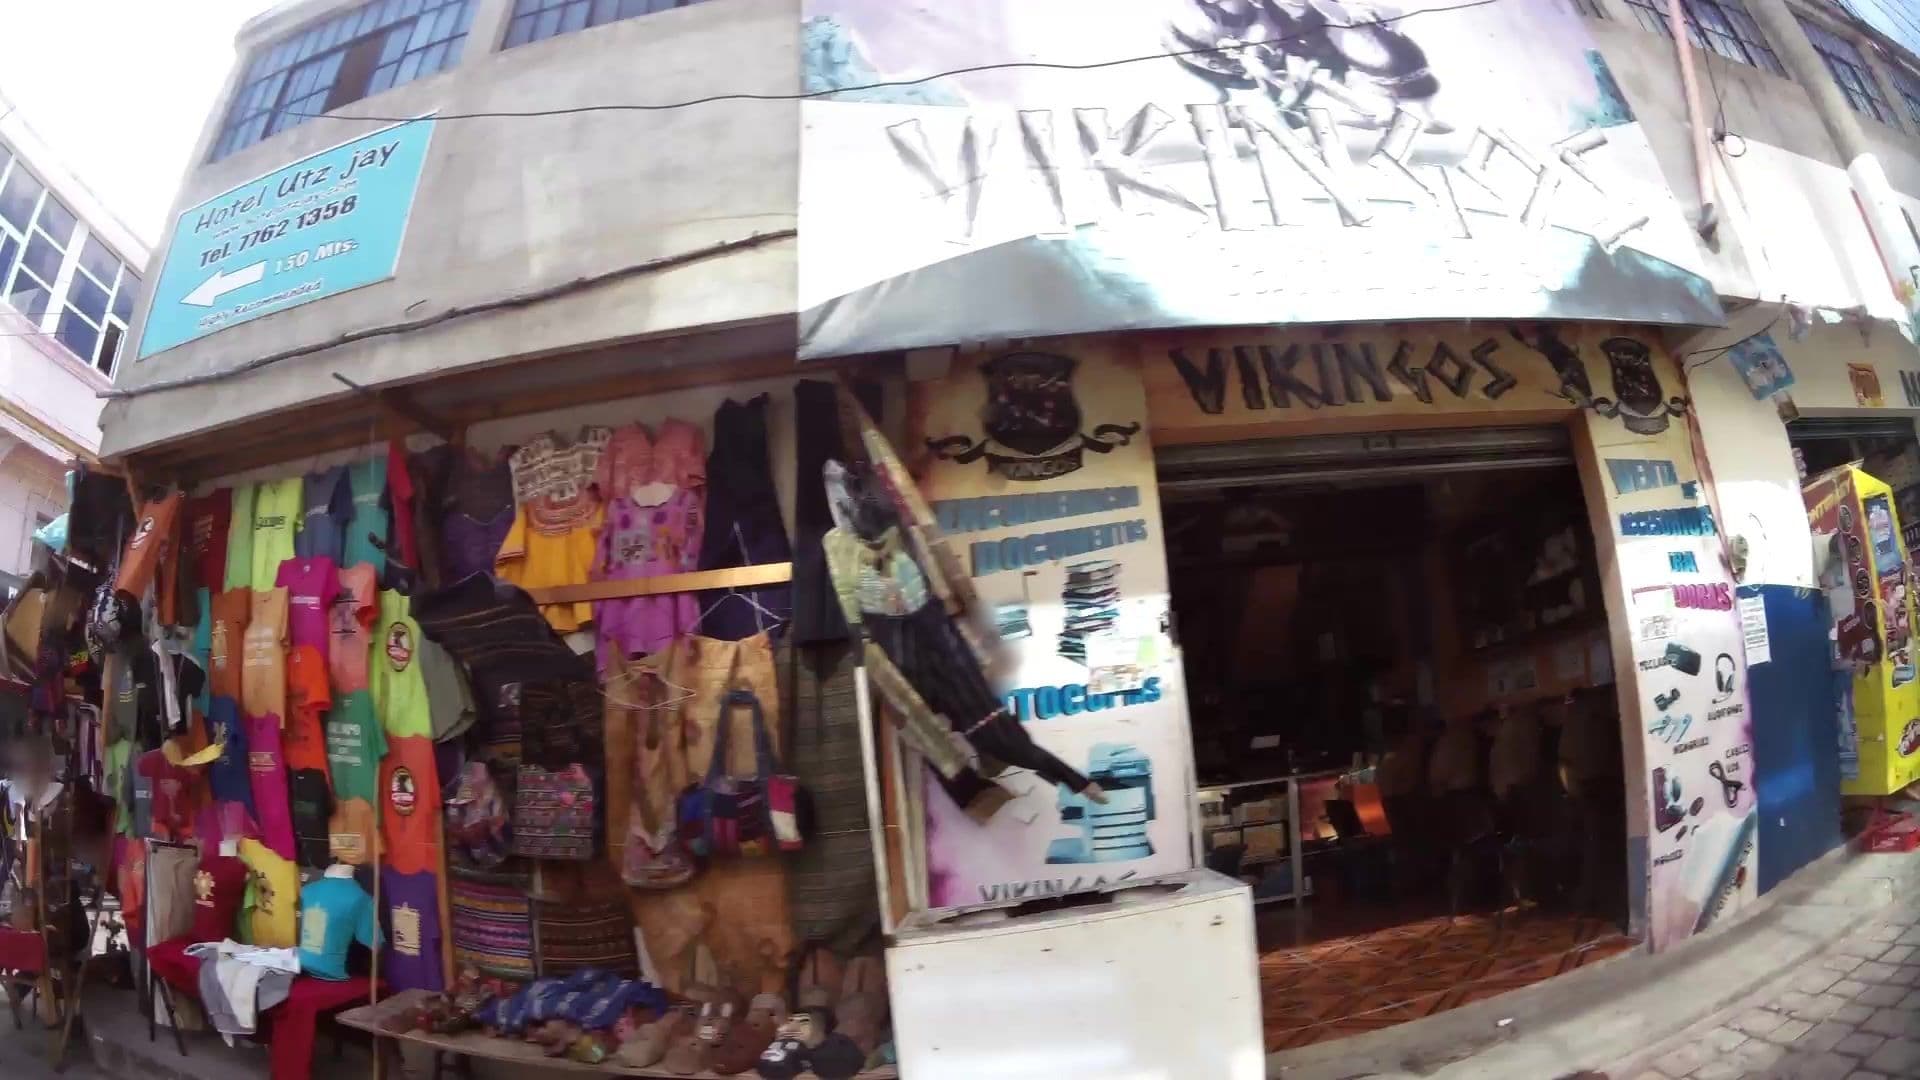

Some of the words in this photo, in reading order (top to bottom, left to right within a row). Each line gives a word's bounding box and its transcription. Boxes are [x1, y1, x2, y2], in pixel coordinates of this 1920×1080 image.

[194, 185, 268, 234] Hotel
[277, 166, 332, 198] Utz
[339, 140, 400, 180] jay
[200, 241, 233, 268] Tel.
[238, 219, 290, 251] 7762
[295, 194, 358, 229] 1358
[272, 249, 310, 276] 150
[313, 238, 359, 262] Mts.
[1168, 338, 1517, 415] VIKINGOS
